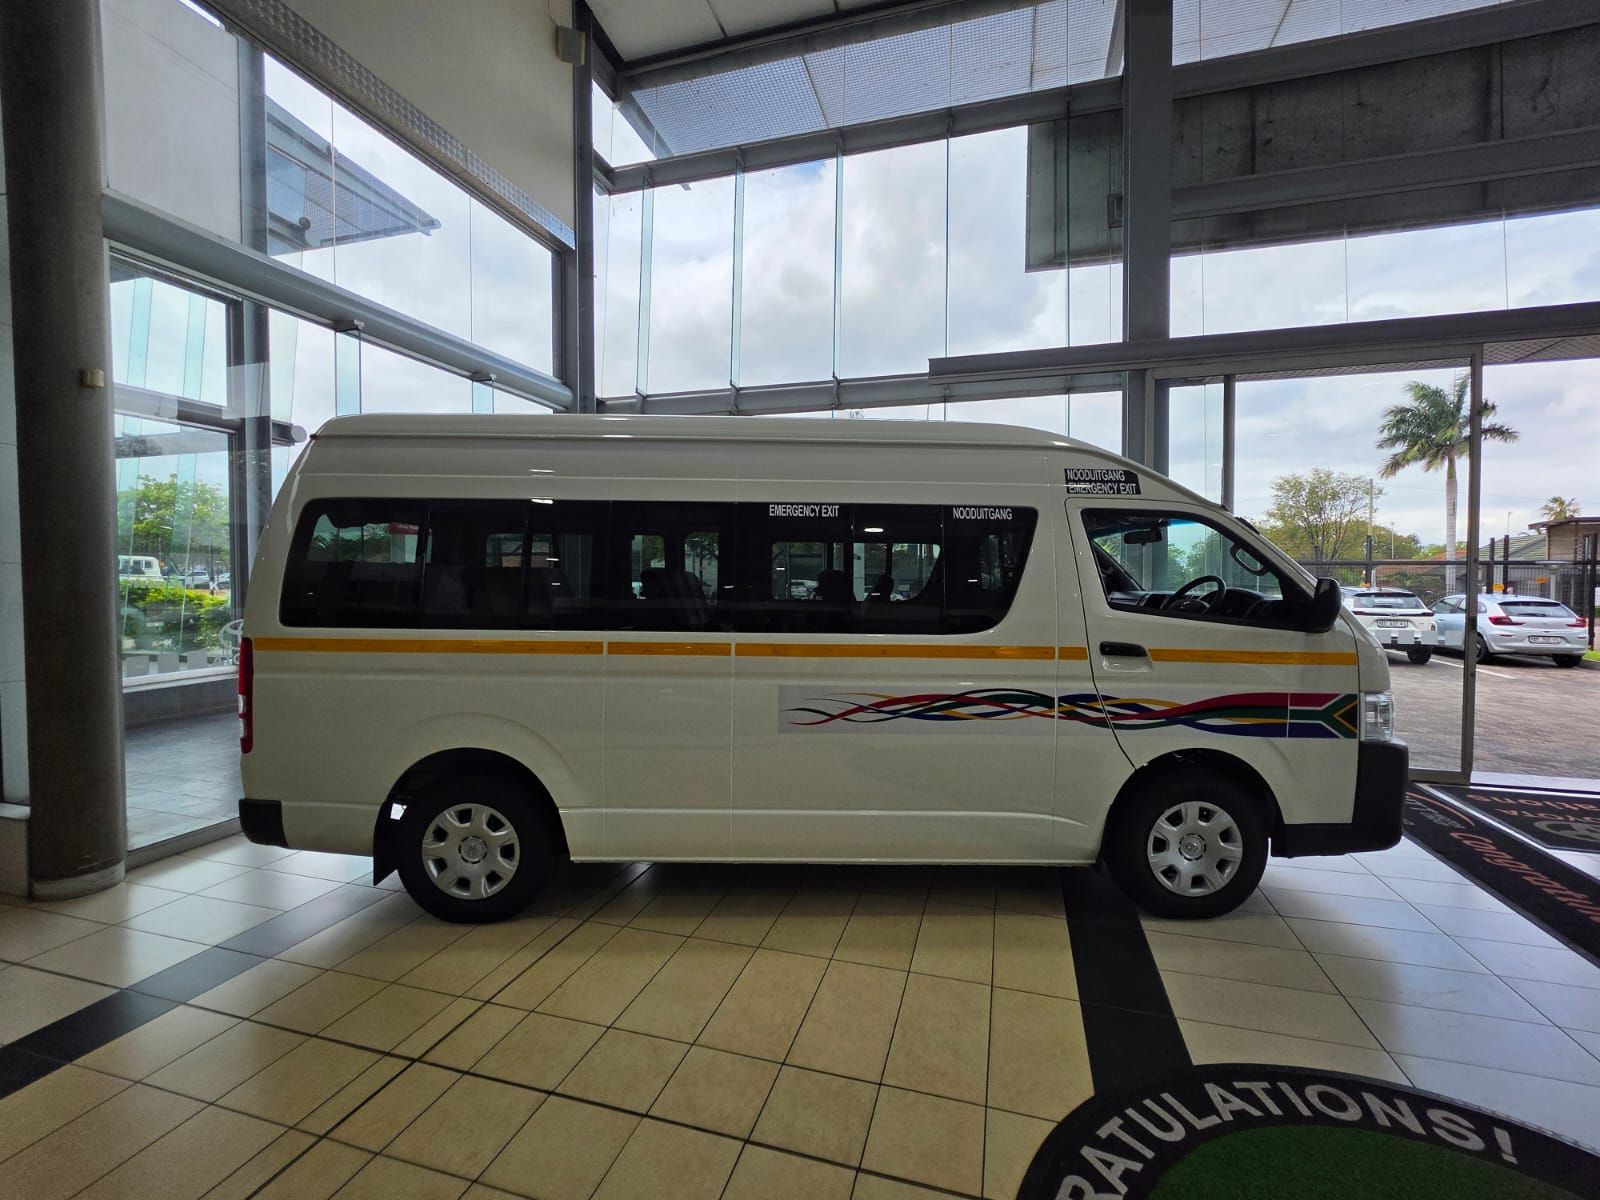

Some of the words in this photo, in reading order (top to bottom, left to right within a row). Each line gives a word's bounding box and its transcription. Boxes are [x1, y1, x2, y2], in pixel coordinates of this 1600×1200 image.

[1067, 469, 1126, 481] NOODUITGANG
[1068, 482, 1118, 494] EMERGENCY
[1119, 483, 1137, 494] EXIT
[769, 504, 820, 517] EMERGENCY
[821, 505, 840, 518] EXIT
[953, 507, 1012, 520] NOODUITGANG
